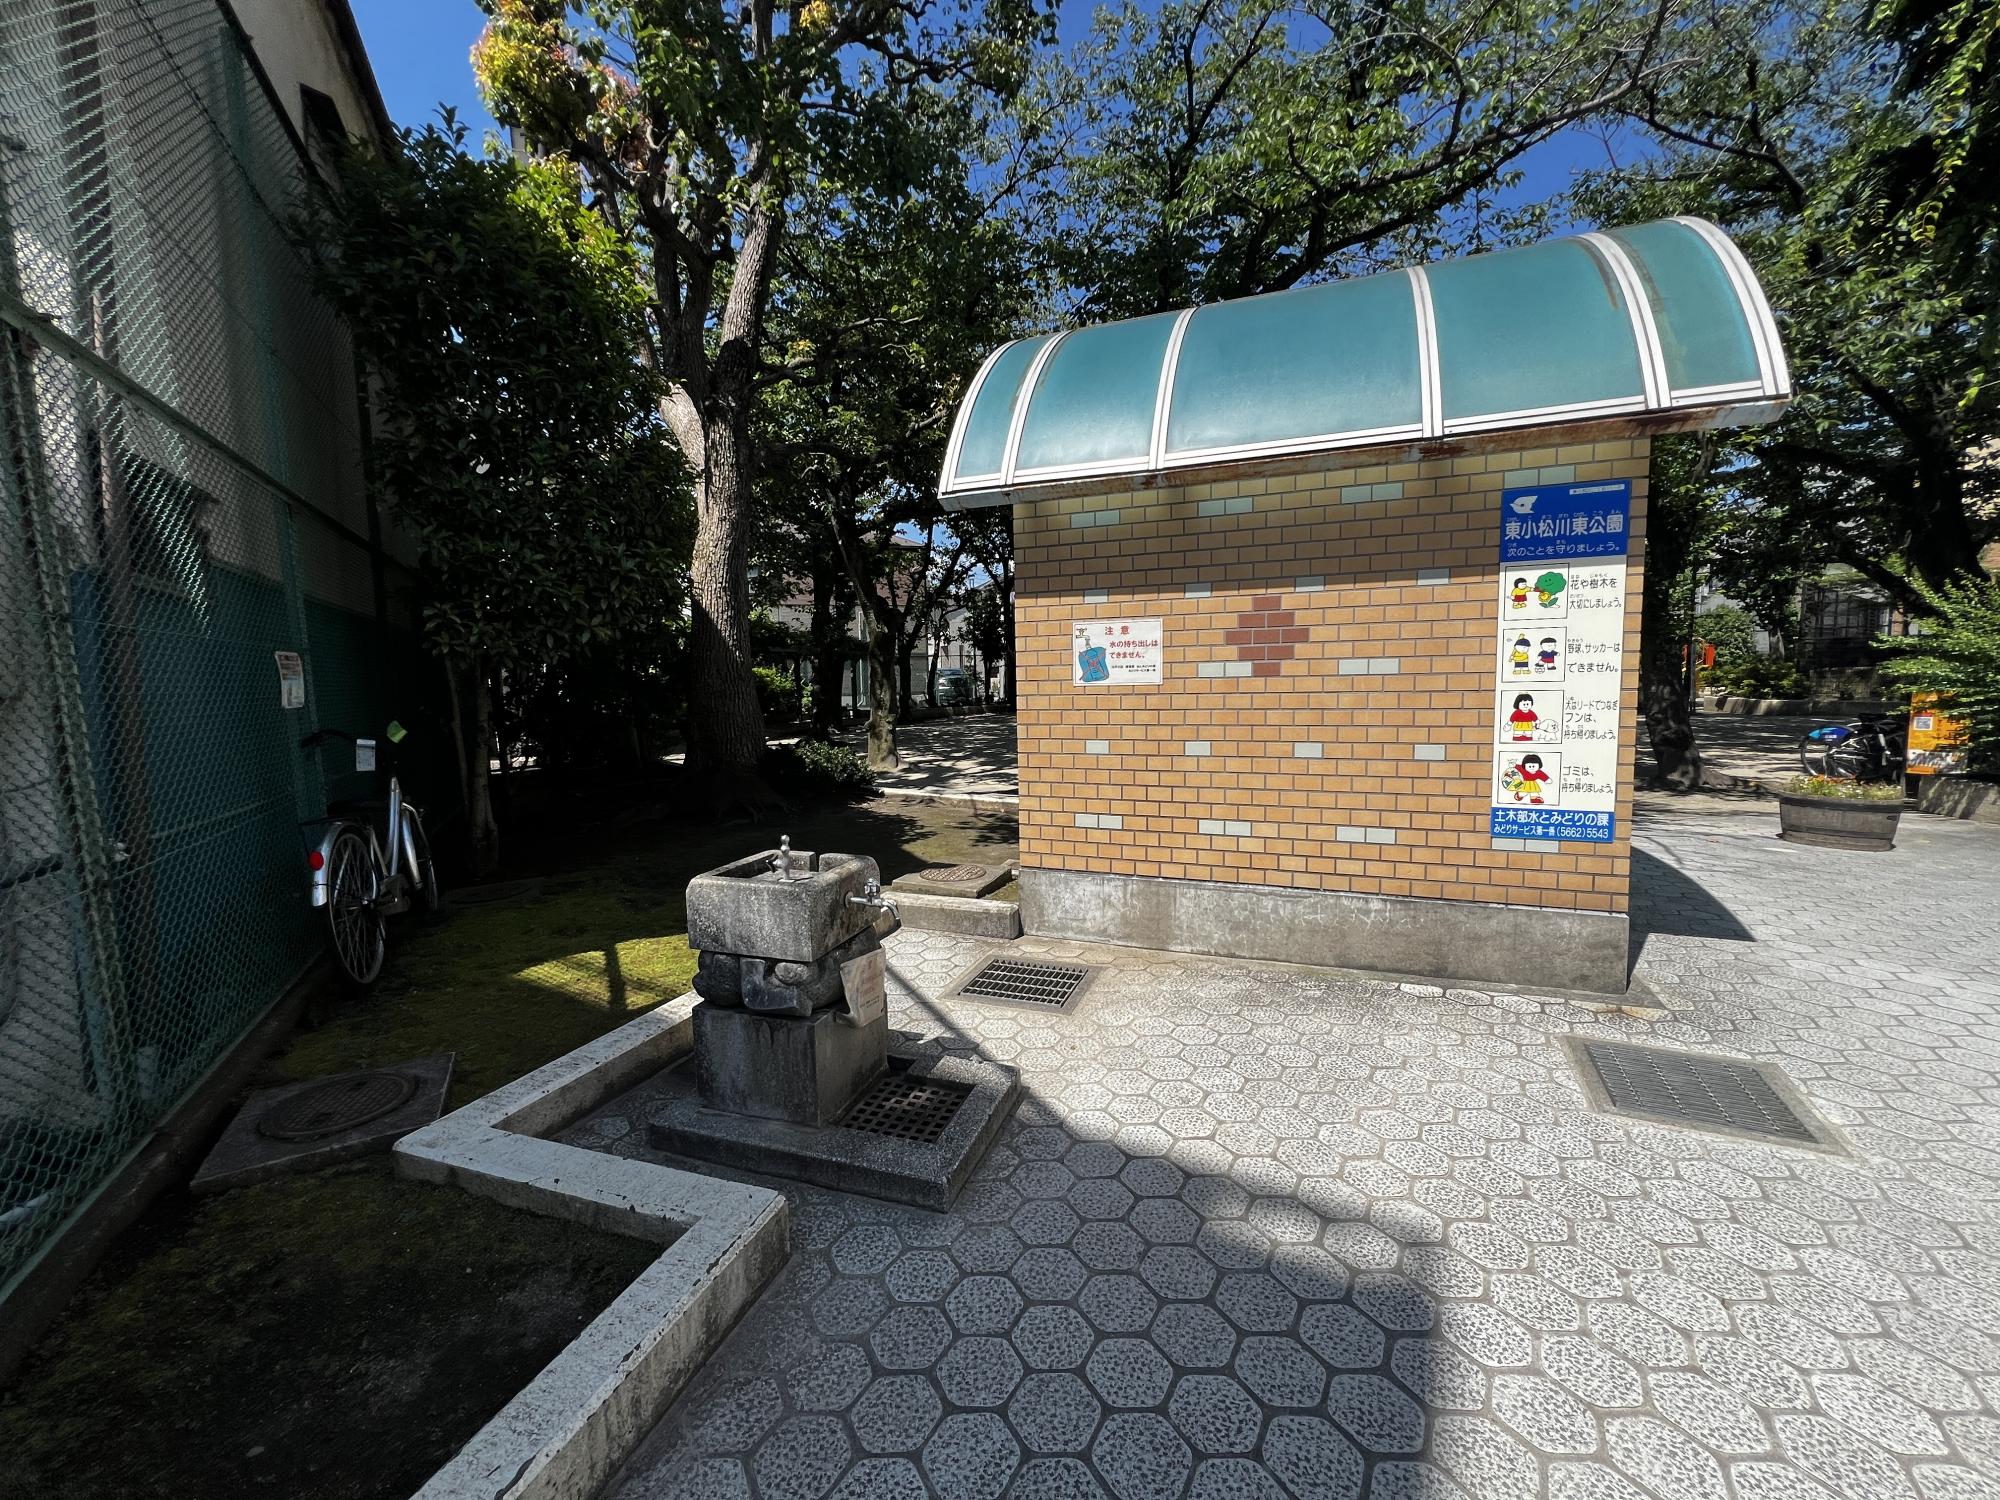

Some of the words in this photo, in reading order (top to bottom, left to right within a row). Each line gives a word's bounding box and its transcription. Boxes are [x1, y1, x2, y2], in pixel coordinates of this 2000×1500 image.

[1505, 514, 1623, 540] 東小松川東公園
[1507, 541, 1620, 557] 次のことを守りましょう。
[1570, 578, 1617, 590] 花や樹木を
[1569, 597, 1622, 610] 大切にしましょう。
[1109, 639, 1158, 649] 水の持ち出しは
[1567, 643, 1620, 654] 野球、サッカーは
[1109, 651, 1145, 660] できません。
[1567, 662, 1619, 673] できません。
[1565, 712, 1597, 723] フンは、
[1563, 729, 1616, 740] 持ち帰りましょう。
[1562, 766, 1594, 777] ゴミは、
[1561, 783, 1614, 794] 持ち帰りましょう。
[1494, 809, 1609, 827] 土木部水とみどりの課
